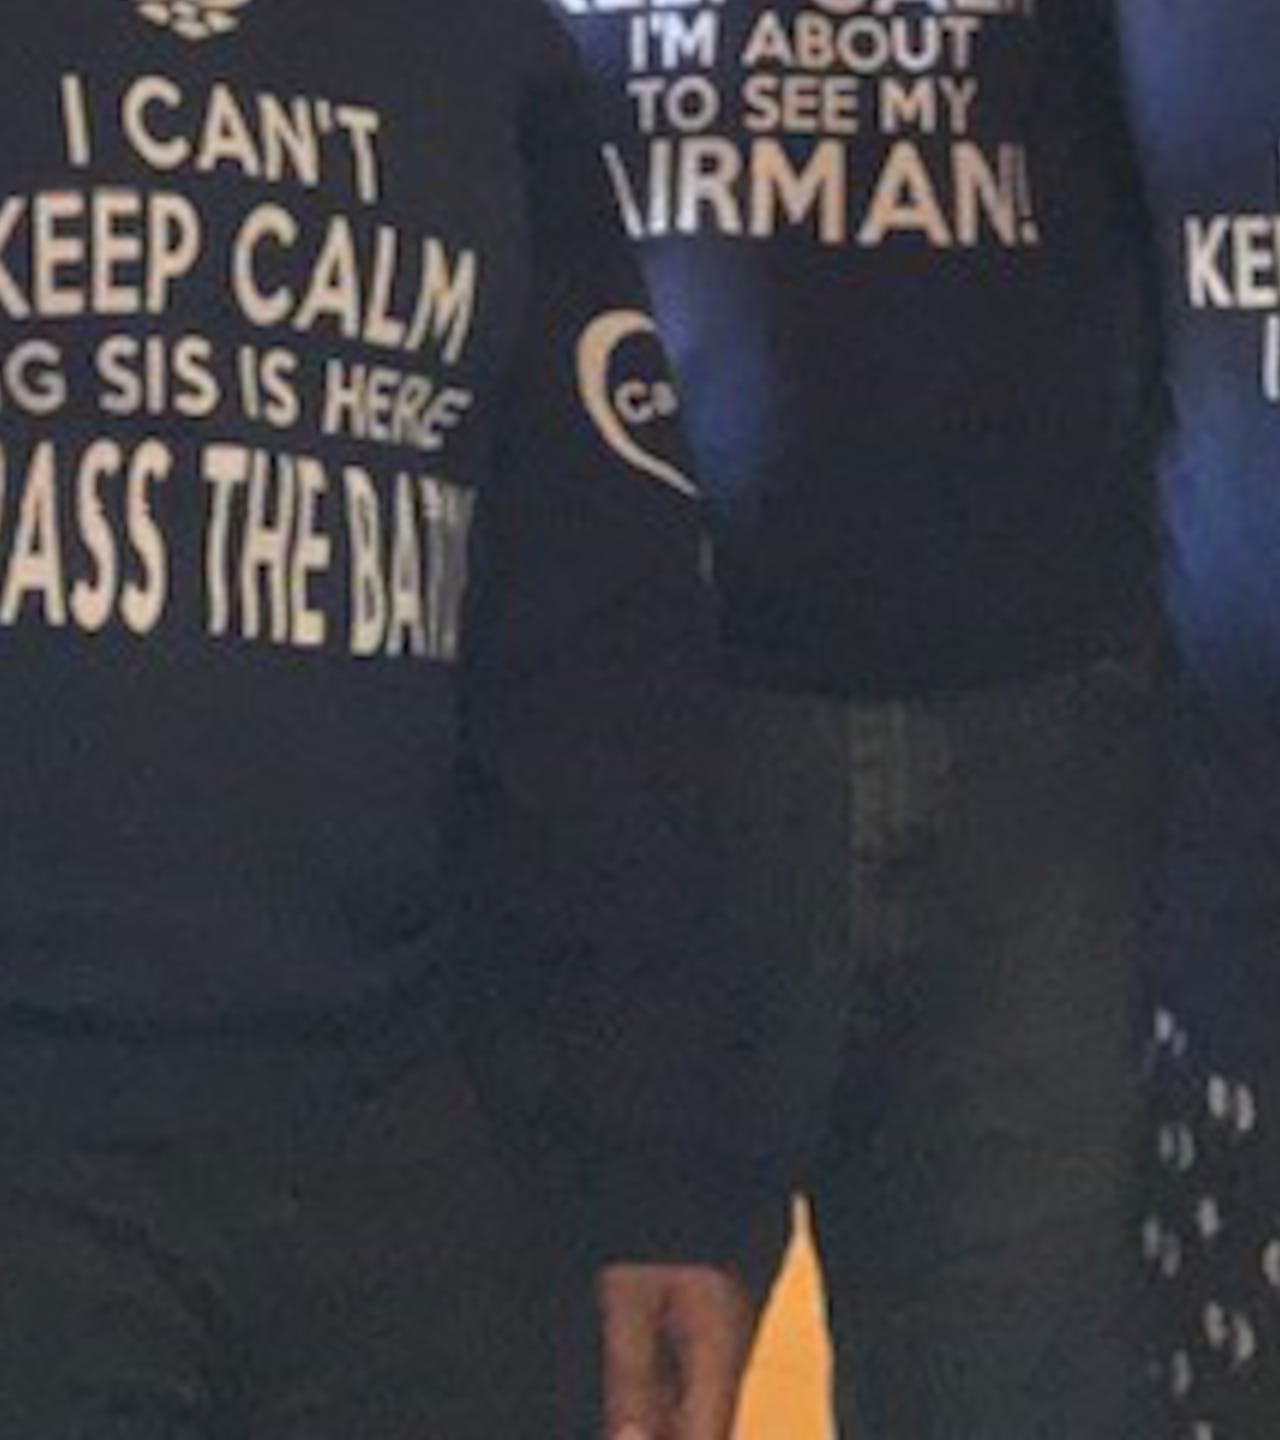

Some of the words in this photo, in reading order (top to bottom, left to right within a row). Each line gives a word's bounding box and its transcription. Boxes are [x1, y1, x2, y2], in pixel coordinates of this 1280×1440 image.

[631, 12, 718, 71] I'M
[741, 13, 980, 72] ABOUT
[61, 73, 91, 167] I
[123, 76, 380, 204] CAN'T
[629, 76, 719, 133] TO
[743, 76, 860, 133] SEE
[880, 76, 979, 135] MY
[234, 204, 477, 363] CALM
[97, 338, 220, 418] SIS
[241, 347, 301, 429] IS
[325, 362, 473, 451] HERE
[204, 444, 331, 648] THE
